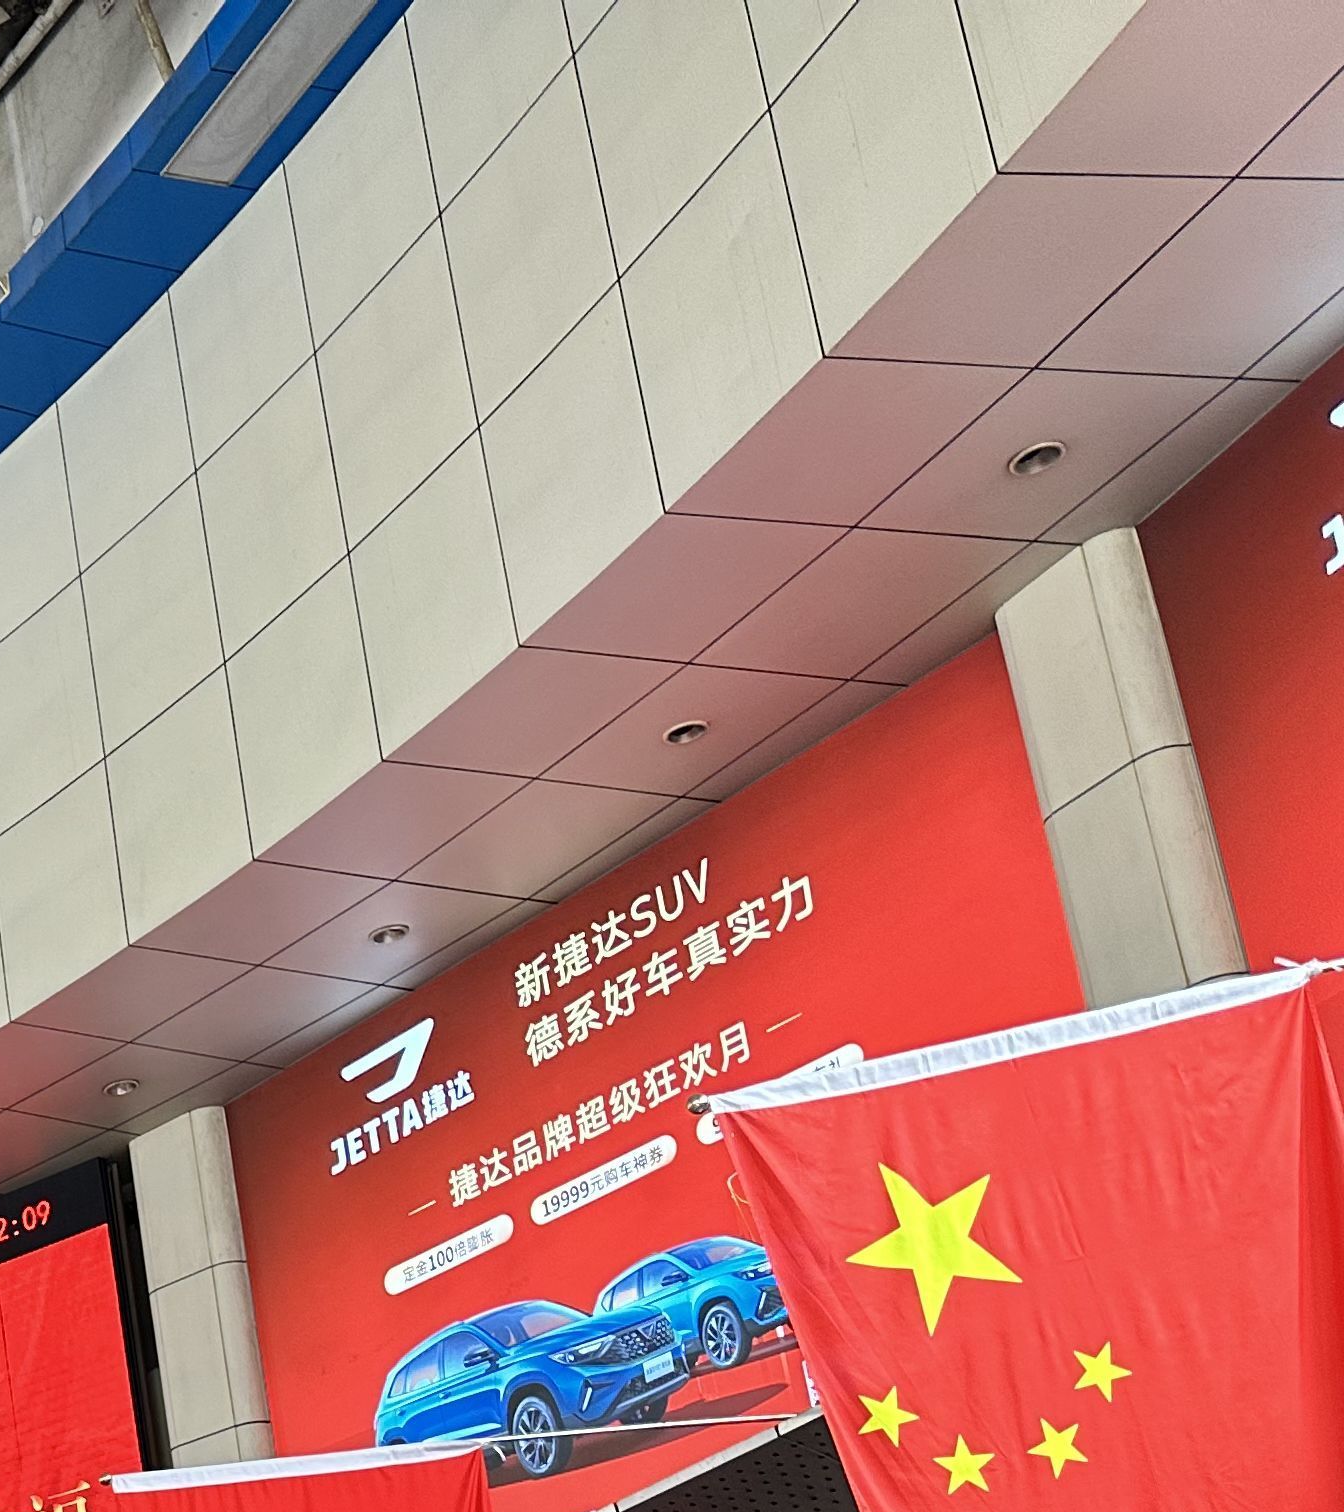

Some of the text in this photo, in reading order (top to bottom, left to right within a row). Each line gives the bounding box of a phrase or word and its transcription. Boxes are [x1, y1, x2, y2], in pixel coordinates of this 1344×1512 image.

[514, 858, 710, 1009] 新捷达SUV
[524, 876, 814, 1067] 德系好车真实力
[329, 1070, 476, 1176] JETTA捷达
[448, 1022, 752, 1208] 捷达品牌超级狂欢月
